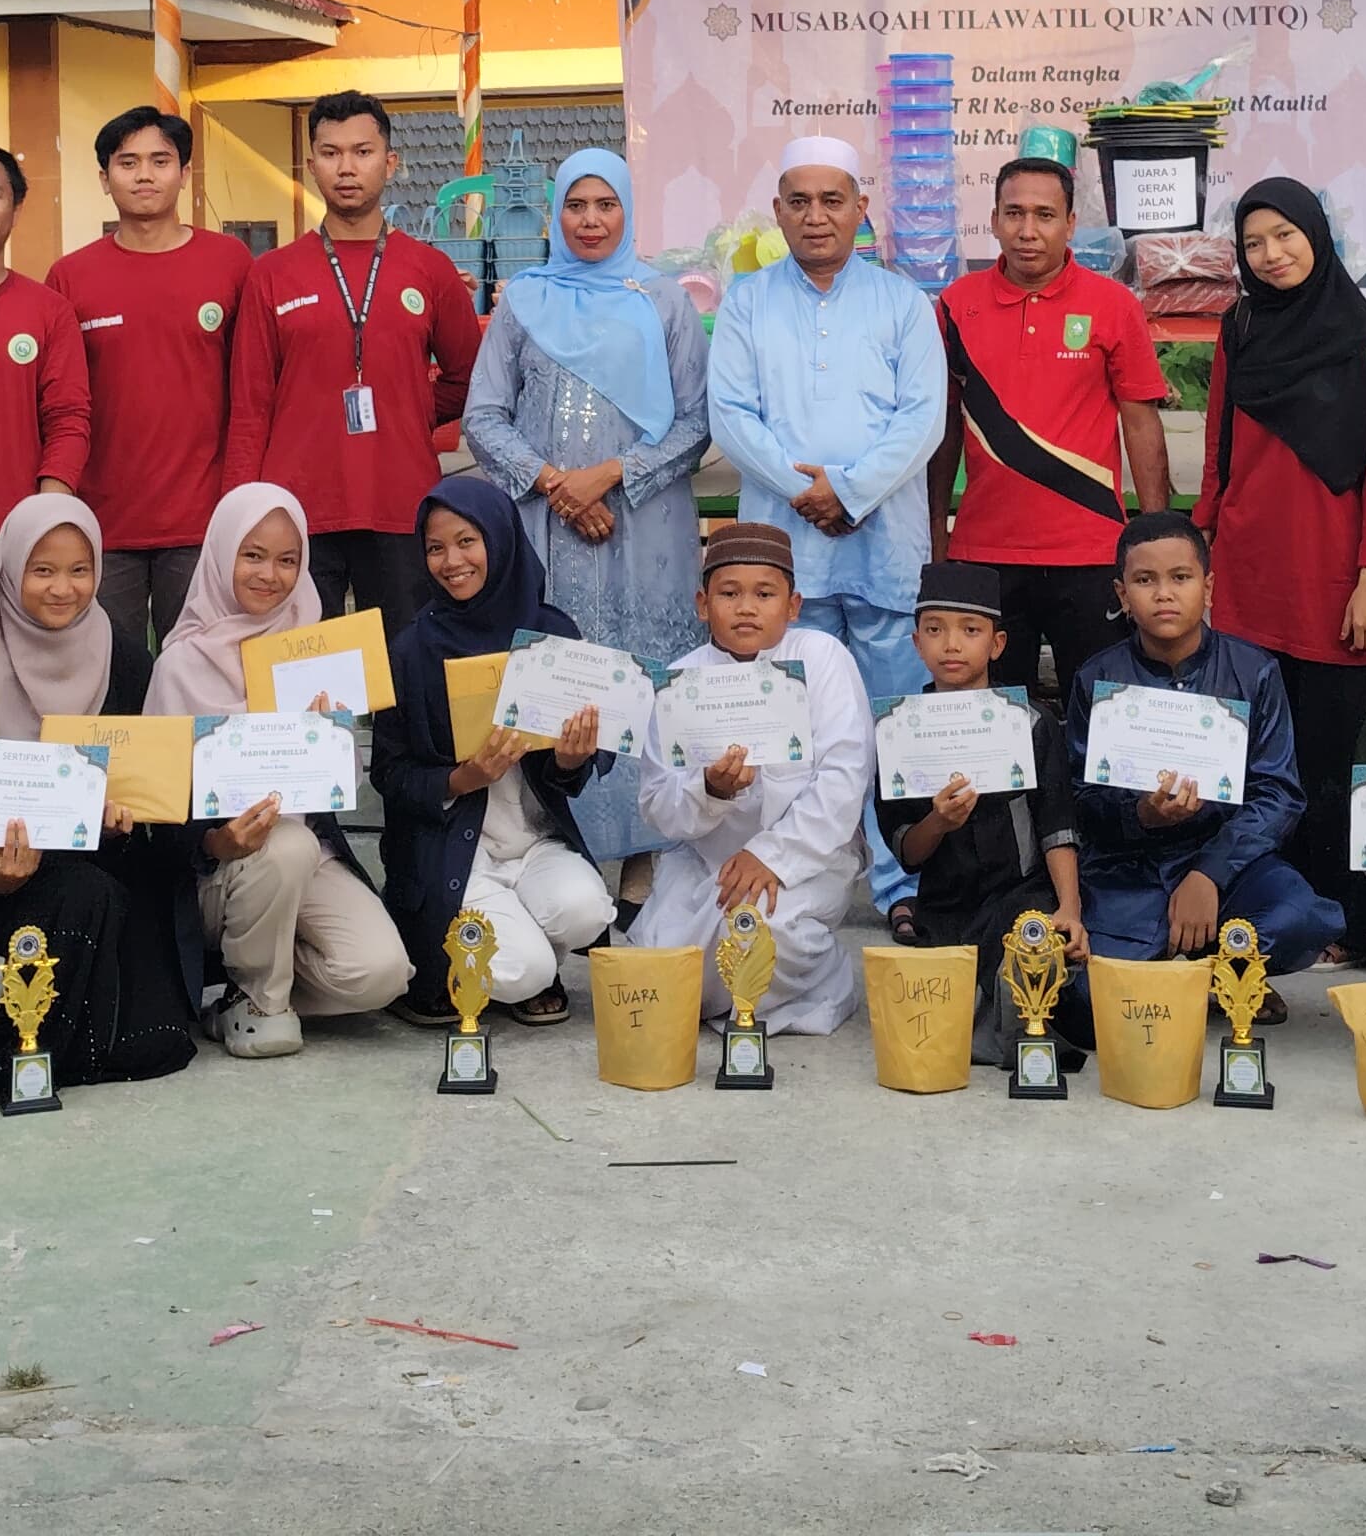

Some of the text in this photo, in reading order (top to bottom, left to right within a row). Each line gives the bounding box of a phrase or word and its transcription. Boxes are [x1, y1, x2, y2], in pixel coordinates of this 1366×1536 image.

[750, 9, 930, 35] MUSABAQAH
[938, 7, 1096, 31] TILAWATIL
[1222, 5, 1309, 30] (MTQ)
[971, 65, 1120, 86] Dalam Rangka
[772, 99, 881, 116] Memeriah
[968, 98, 987, 114] RI
[993, 97, 1054, 114] Ke-80
[1250, 94, 1328, 112] Maulid
[954, 128, 979, 146] abi
[1132, 167, 1177, 178] JUARA 3
[1137, 183, 1176, 193] GERAK
[1138, 197, 1174, 207] JALAN
[1137, 211, 1176, 221] HEBOH
[276, 634, 328, 661] JUARA
[705, 672, 752, 687] SERTIFIKAT
[926, 701, 973, 714] SERTIFIKAT
[1147, 698, 1194, 713] SERTIFIKAT
[82, 722, 131, 746] JUARA
[250, 723, 298, 733] SERTIFIKAT
[2, 751, 52, 763] SERTIFIKAT
[608, 983, 660, 1007] JUARA
[893, 972, 952, 1005] JUARA
[1121, 998, 1172, 1021] JUARA
